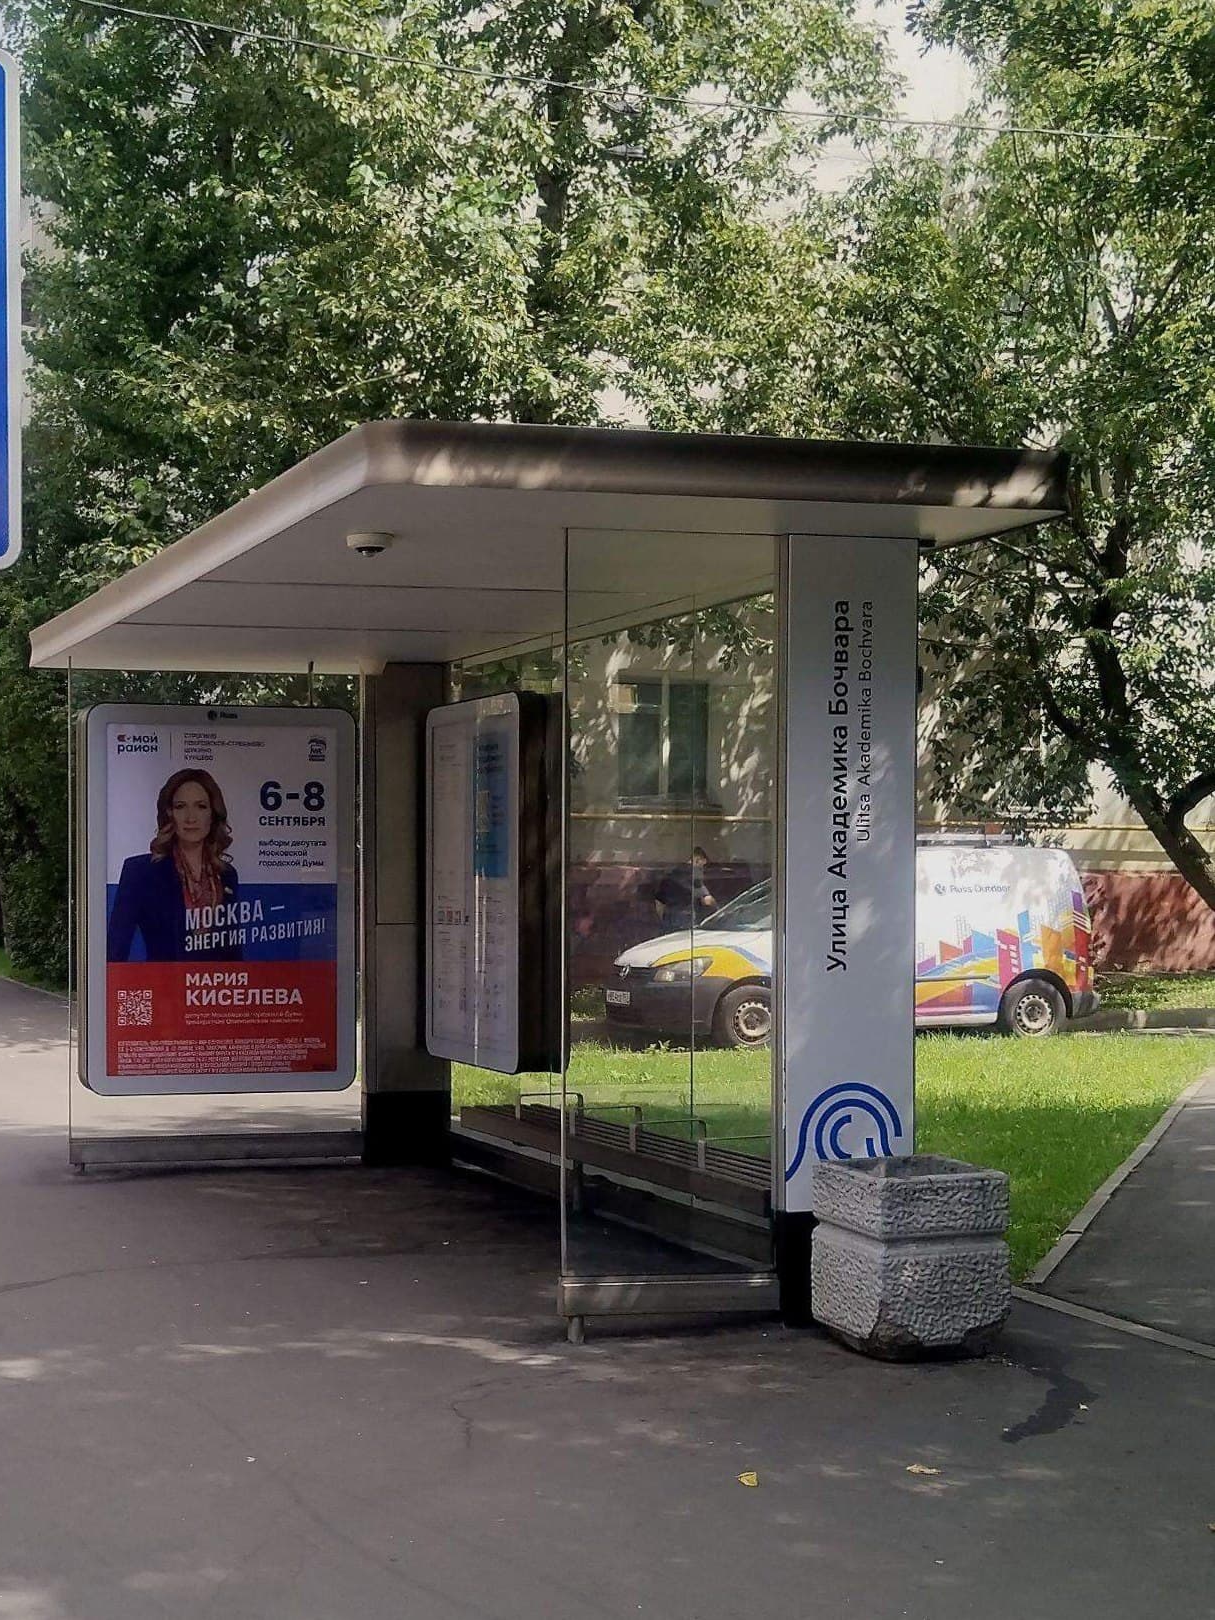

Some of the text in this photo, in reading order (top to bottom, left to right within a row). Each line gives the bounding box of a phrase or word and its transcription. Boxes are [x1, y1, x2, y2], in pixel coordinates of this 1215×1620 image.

[857, 601, 873, 842] Ulitsa Akademika Bochvara
[133, 732, 158, 743] мой
[827, 600, 854, 972] Улица Академика Бочвара
[259, 816, 326, 826] СЕНТЯБРЯ
[259, 839, 289, 848] выборы
[259, 849, 307, 857] Московской
[259, 859, 324, 868] городской Думы
[186, 900, 264, 931] МОСКВА
[185, 918, 326, 952] ЭНЕРГИЯ РАЗВИТИЯ!
[186, 973, 248, 987] МАРИЯ
[186, 989, 303, 1006] КИСЕЛЕВА
